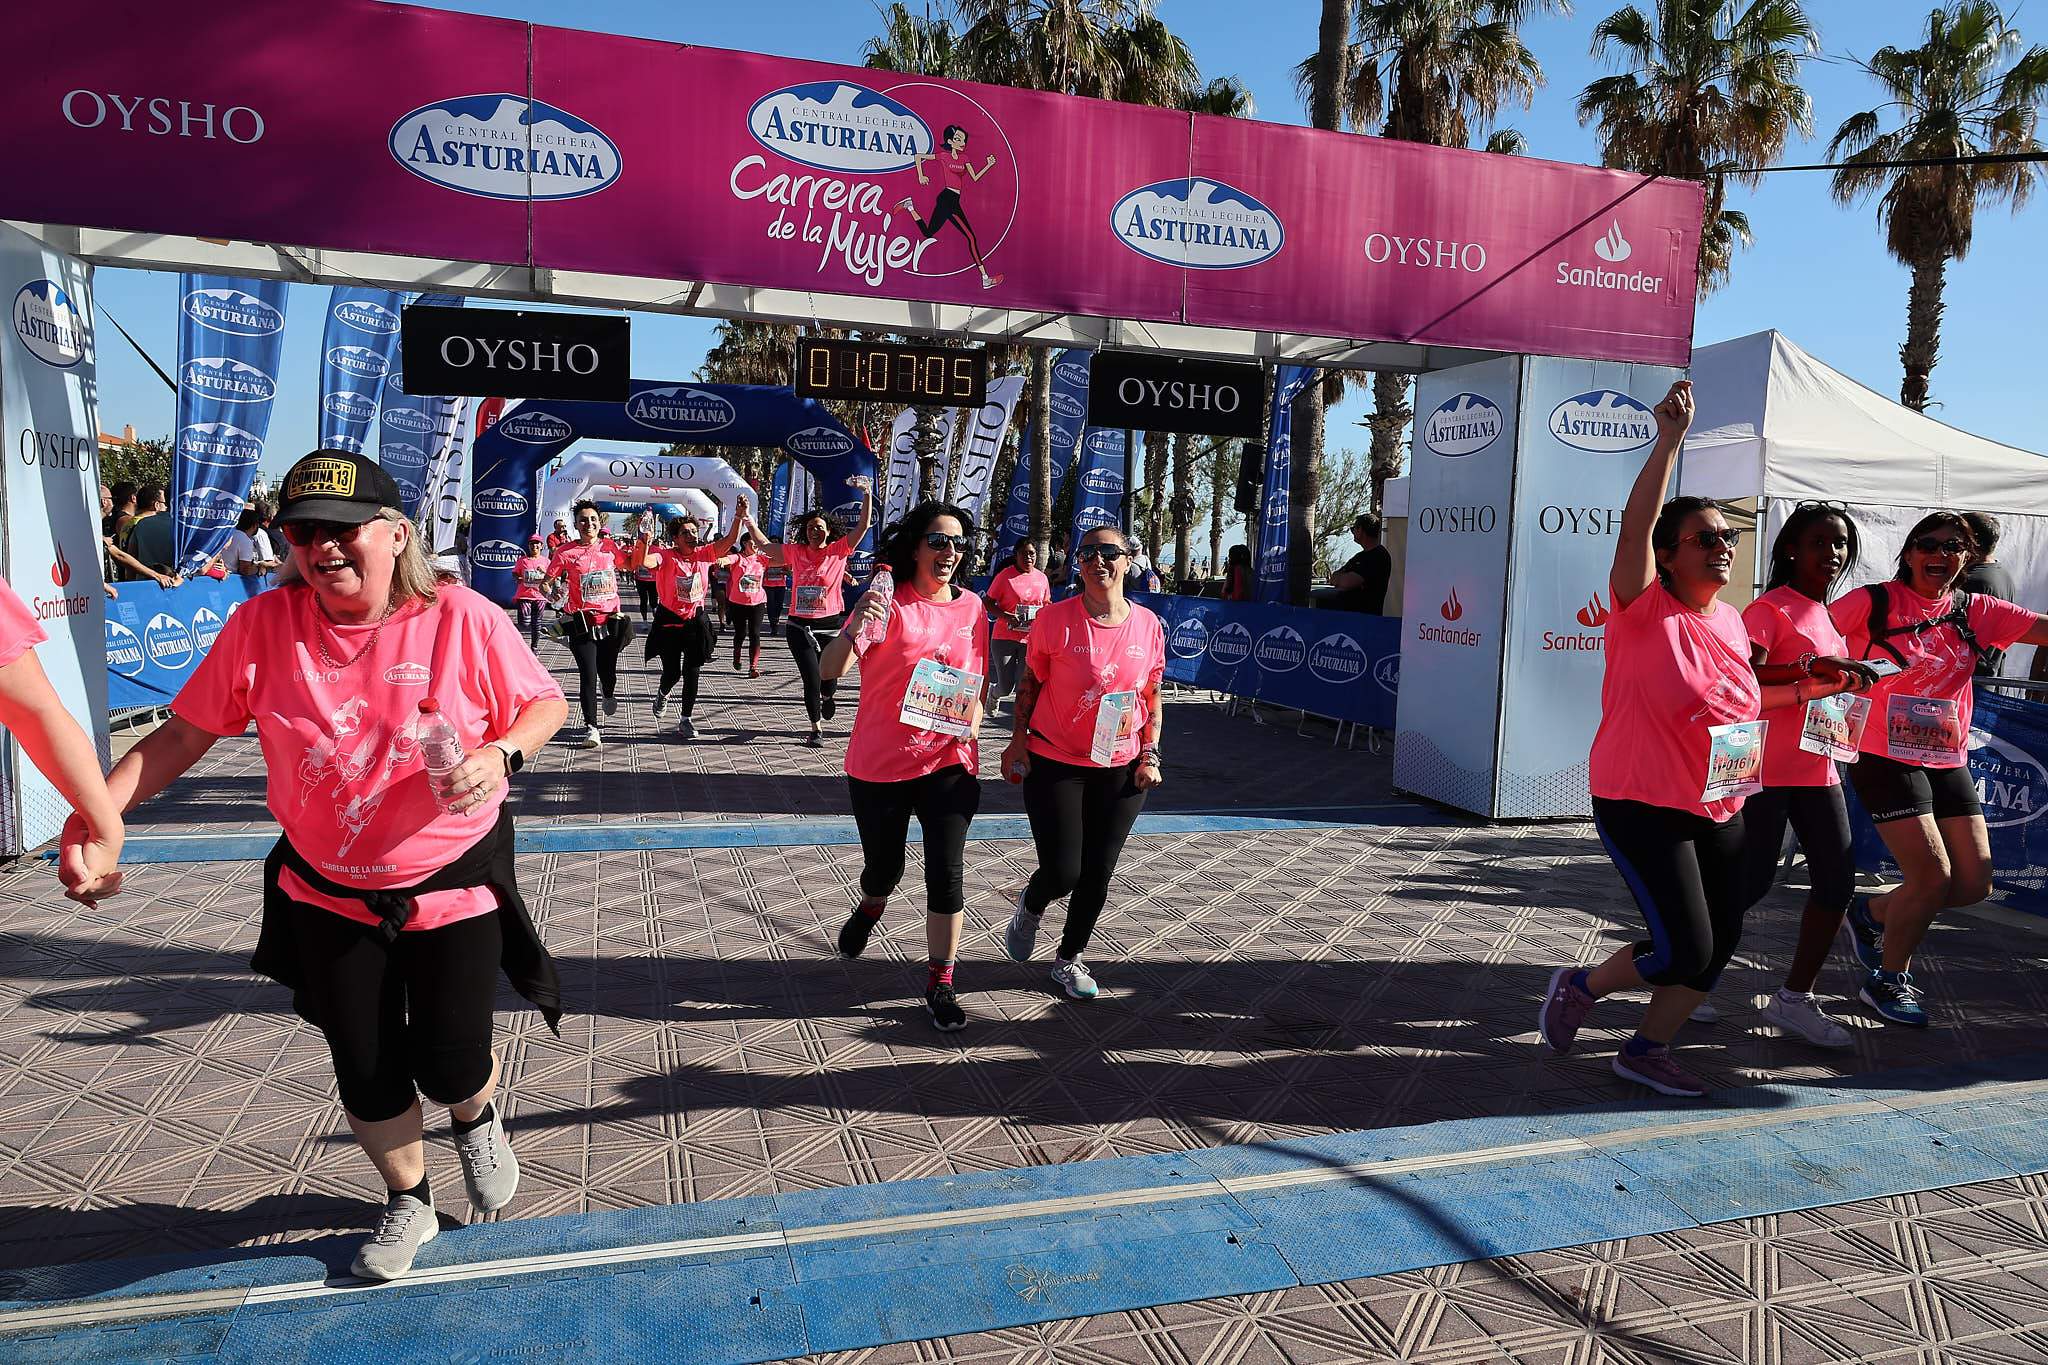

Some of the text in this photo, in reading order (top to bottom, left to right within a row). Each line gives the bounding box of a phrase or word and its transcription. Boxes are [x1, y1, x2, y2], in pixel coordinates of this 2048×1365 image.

[62, 90, 265, 144] OYSHO
[792, 106, 915, 130] CENTRAL LECHERA
[445, 124, 518, 142] CENTRAL
[763, 106, 919, 156] ASTURIANA
[408, 124, 604, 180] ASTURIANA
[730, 155, 883, 215] Carrera
[767, 208, 823, 243] de la
[1152, 203, 1266, 224] CENTRAL LECHERA
[1124, 204, 1270, 250] ASTURIANA
[817, 211, 938, 287] Mujer
[1364, 233, 1487, 272] OYSHO
[1556, 262, 1663, 293] Santander
[190, 297, 276, 329] ASTURIANA
[340, 306, 396, 331] ASTURIANA
[20, 301, 83, 353] ASTURIANA
[441, 335, 599, 374] OYSHO
[184, 366, 269, 397] ASTURIANA
[810, 348, 972, 396] 01:07:05
[1057, 366, 1088, 385] ASTURIAN
[1118, 377, 1240, 412] OYSHO
[634, 399, 728, 423] ASTURIANA
[1051, 400, 1081, 416] STURIANA
[1440, 410, 1495, 424] CENTRAL LECHERA
[1574, 410, 1649, 421] CENTRAL LECHERA
[386, 413, 431, 430] ASTURIANA
[504, 421, 566, 437] ASTURIANA
[1428, 420, 1496, 443] ASTURIANA
[1556, 410, 1650, 440] ASTURIANA
[20, 428, 90, 472] OYSHO
[180, 433, 259, 459] ASTURIANA
[381, 447, 425, 465] ASTURIANA
[792, 438, 850, 450] ASTURIANA
[957, 401, 1006, 508] YSHO
[1090, 437, 1124, 451] ASTURIA
[292, 470, 349, 488] COMUNA 13
[609, 460, 695, 480] OYSHO
[887, 431, 916, 519] YSHO
[475, 498, 524, 511] ASTURIANA
[773, 485, 788, 523] Marlene
[1419, 505, 1496, 533] OYSHO
[1539, 505, 1624, 534] OYSH
[33, 592, 90, 620] Santander
[150, 636, 192, 658] ASTURIANA
[1212, 637, 1248, 655] ASTURIANA
[1419, 622, 1481, 647] Santander
[1543, 631, 1605, 651] Santan
[1257, 640, 1300, 663] ASTURIANA
[1311, 648, 1359, 674] ASTURIANA
[1825, 718, 1844, 733] 016
[1725, 757, 1746, 771] 016
[1968, 758, 2031, 780] ECHERA
[322, 861, 349, 873] CARRERA
[350, 865, 360, 874] DE
[371, 864, 398, 873] MUJER
[490, 1337, 593, 1358] timingsense
